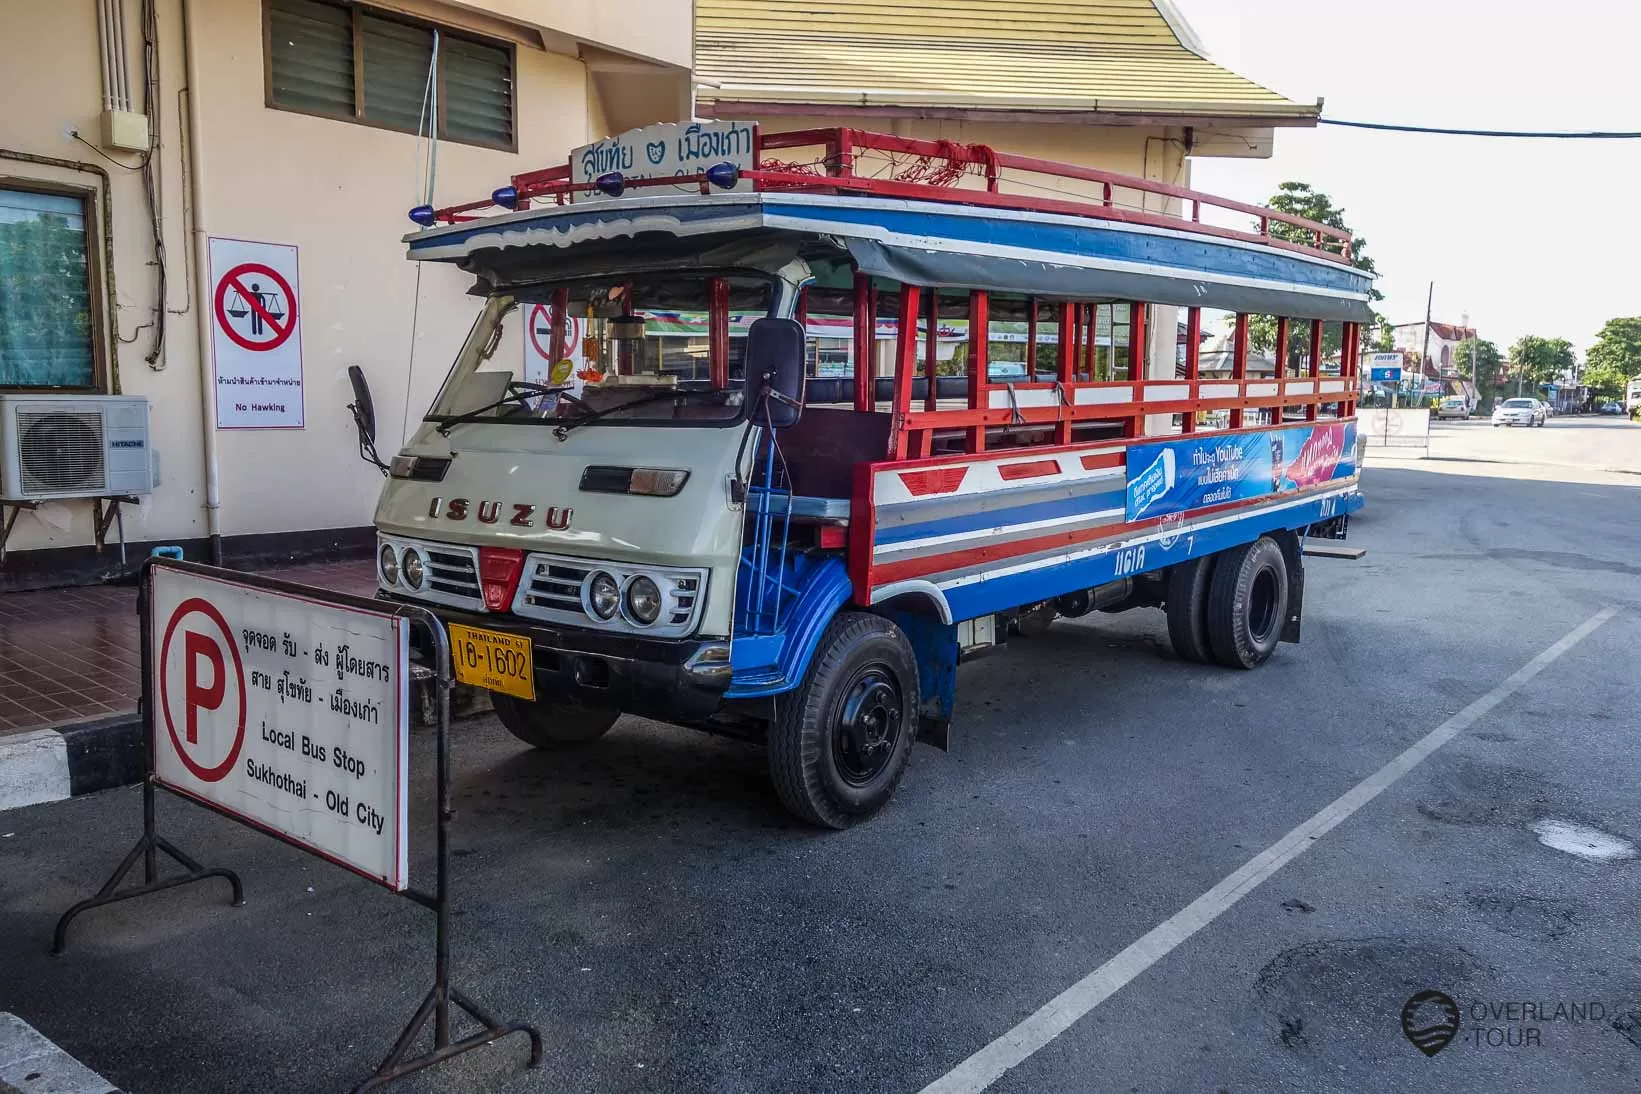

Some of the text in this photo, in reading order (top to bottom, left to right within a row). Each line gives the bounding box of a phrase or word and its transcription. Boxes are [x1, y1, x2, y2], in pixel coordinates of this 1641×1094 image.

[678, 122, 750, 162] เมืองเก่า
[235, 402, 286, 413] No Hawking
[1215, 443, 1243, 462] YouTube
[429, 497, 573, 531] ISUZU
[242, 628, 277, 654] จุดจอด
[282, 632, 297, 658] รับ
[314, 643, 329, 667] ส่ง
[336, 645, 390, 683] ผู้โดยสาร
[467, 631, 511, 646] THAILAND
[457, 639, 527, 681] 10-1602
[185, 630, 226, 745] P
[251, 671, 271, 690] สาย
[277, 670, 312, 704] สุโขทัย
[330, 688, 378, 725] เมืองเก่า
[262, 721, 365, 780] Local Bus Stop
[246, 758, 307, 799] Sukhothai
[326, 790, 349, 817] Old
[356, 802, 385, 836] City
